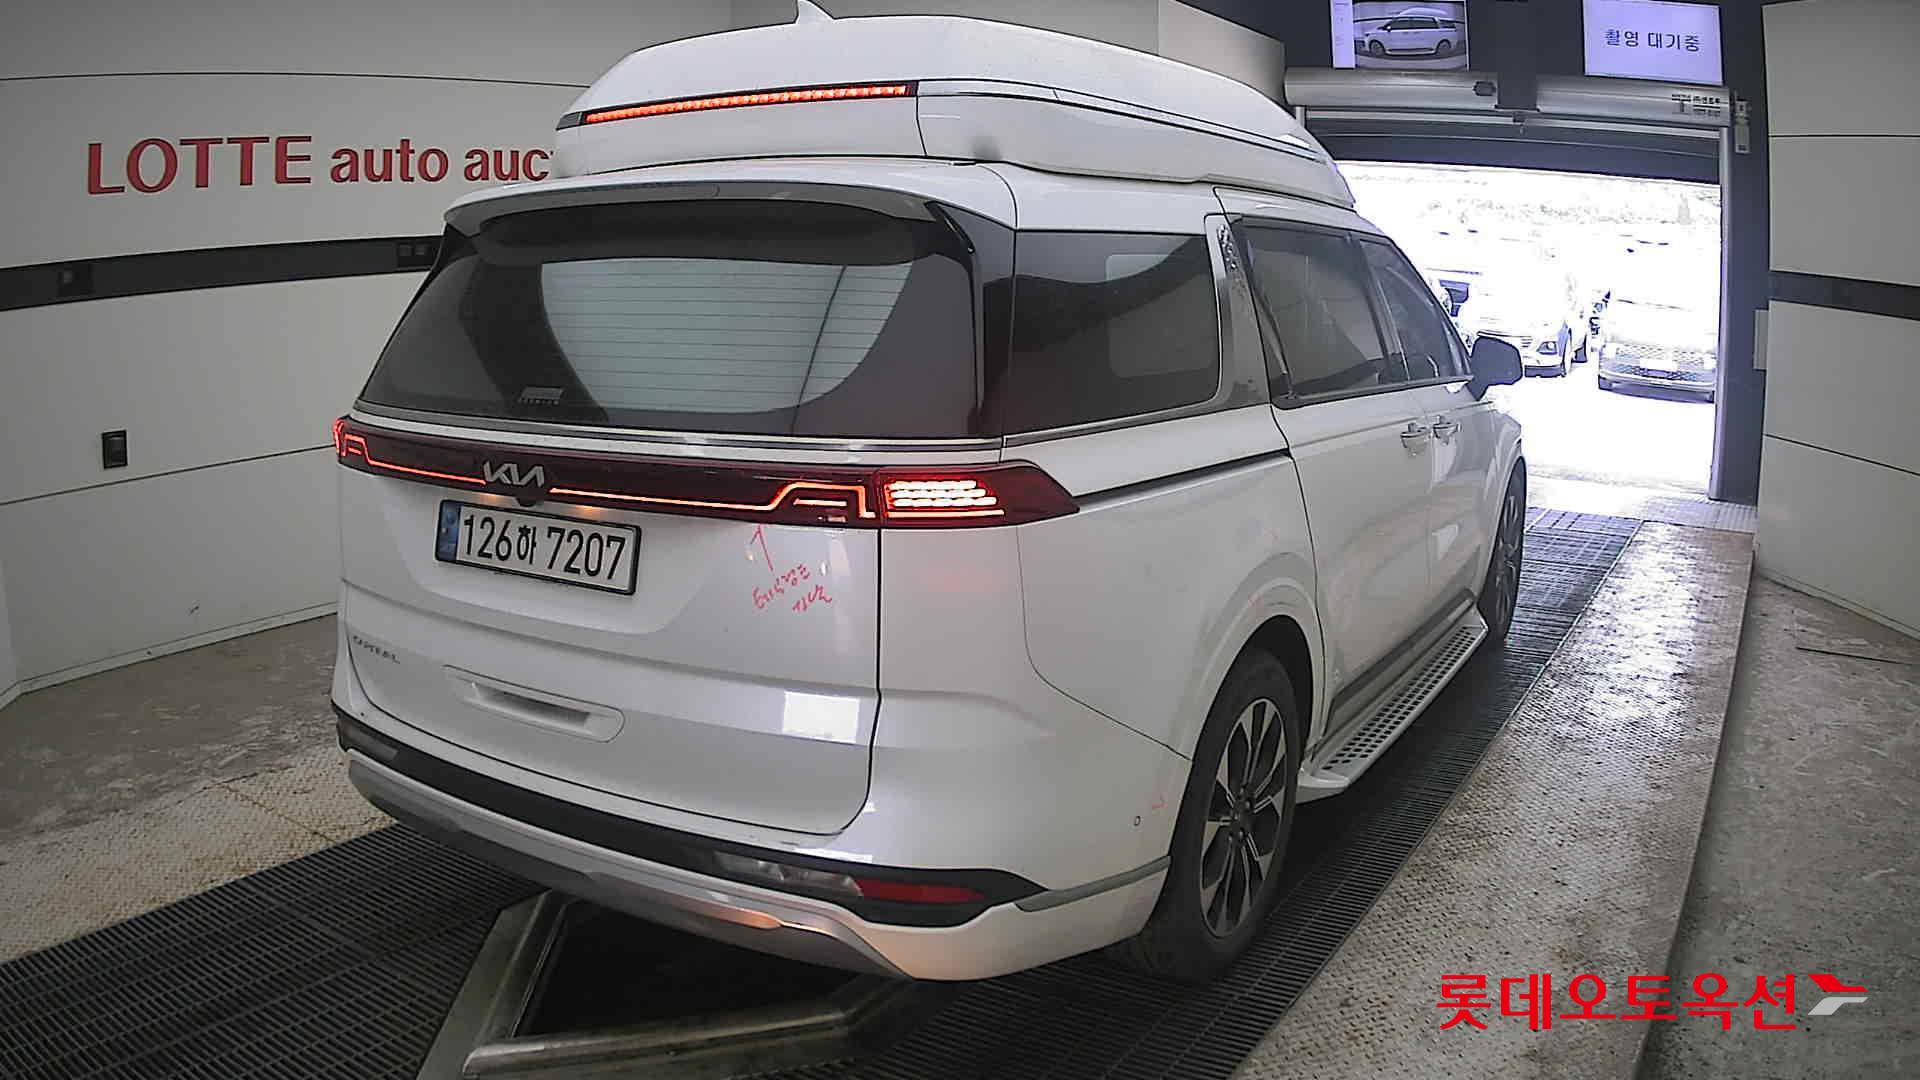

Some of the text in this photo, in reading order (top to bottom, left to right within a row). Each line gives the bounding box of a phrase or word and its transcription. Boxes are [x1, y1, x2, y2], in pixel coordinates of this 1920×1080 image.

[1647, 31, 1700, 53] 대기중
[86, 135, 555, 196] LOTTE auto auc
[482, 461, 545, 488] KIA
[463, 513, 626, 581] 126하 7207
